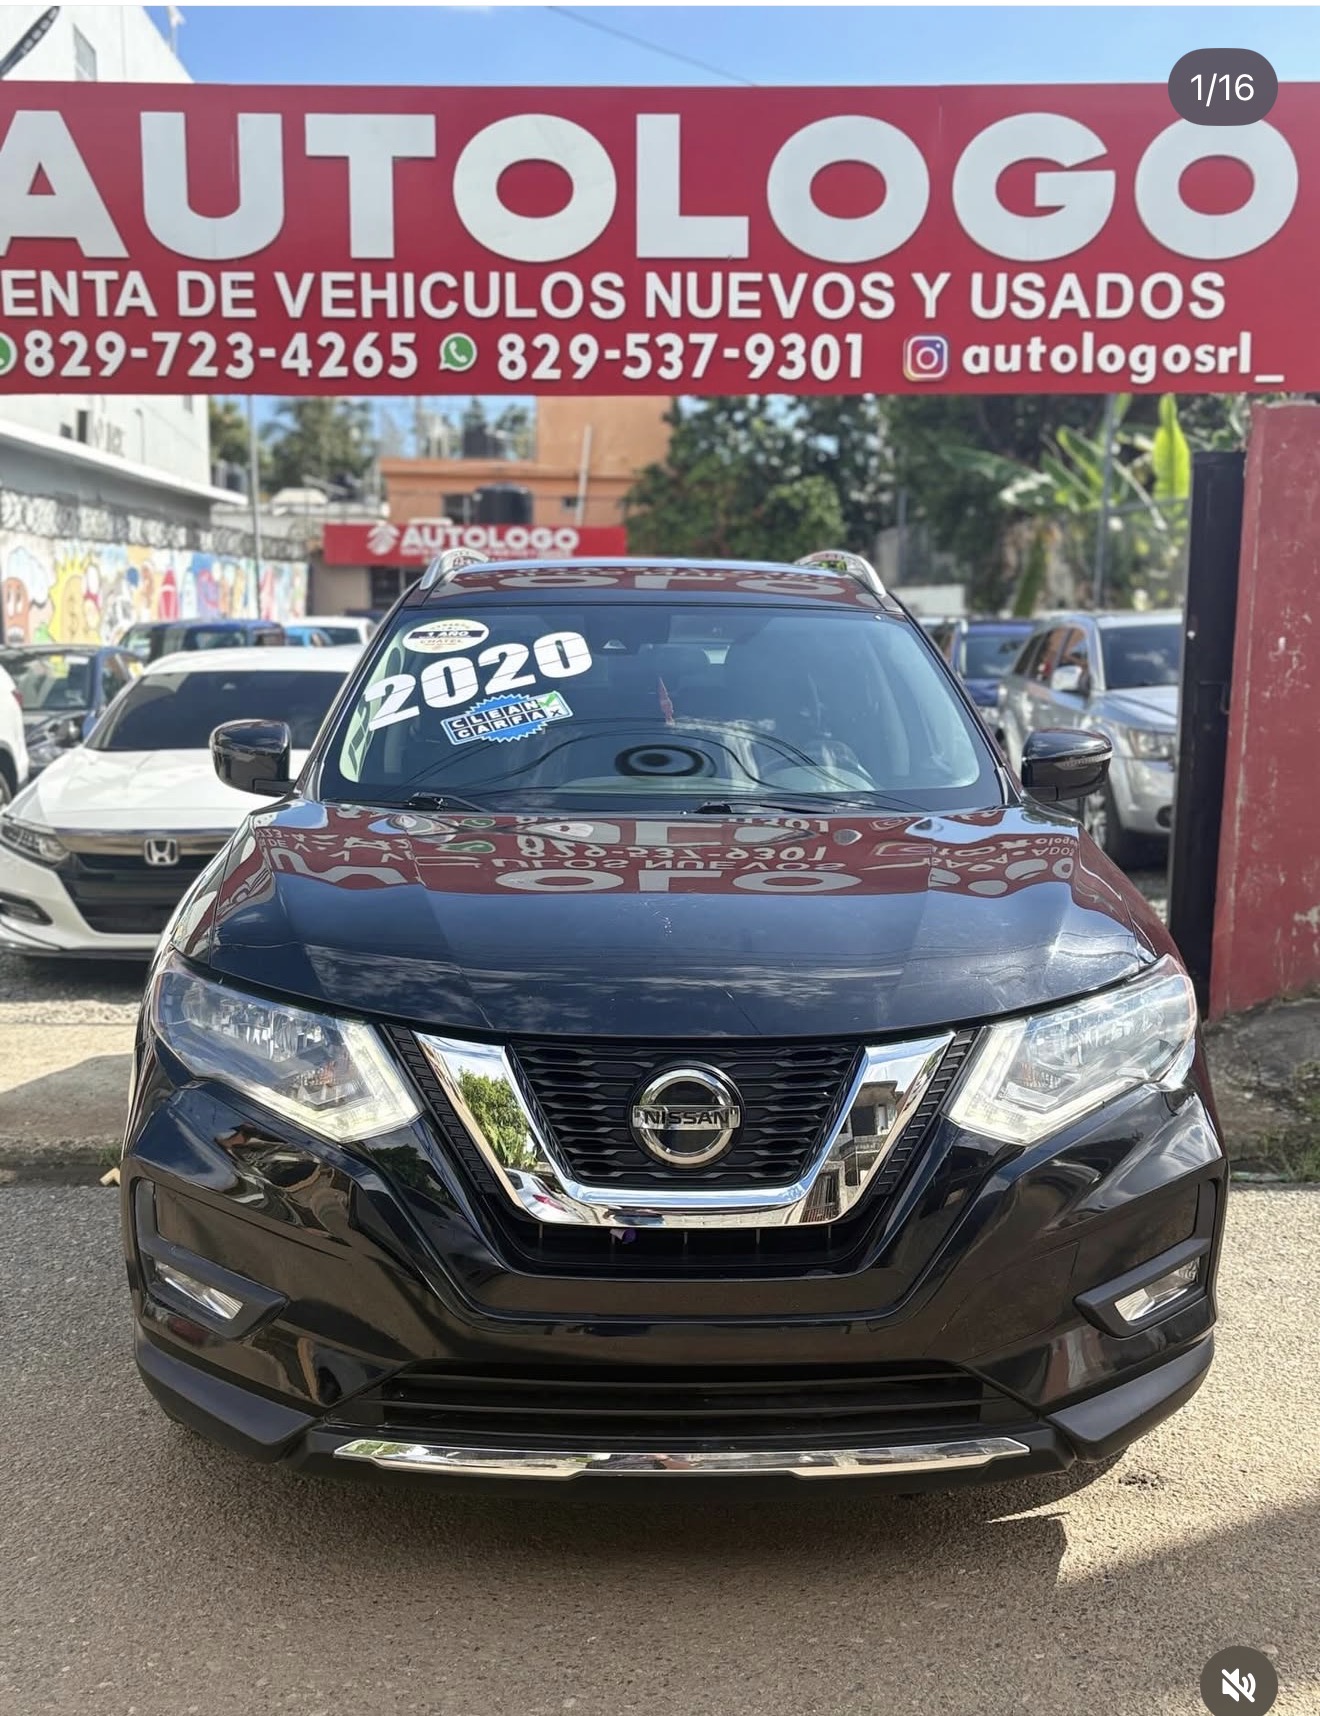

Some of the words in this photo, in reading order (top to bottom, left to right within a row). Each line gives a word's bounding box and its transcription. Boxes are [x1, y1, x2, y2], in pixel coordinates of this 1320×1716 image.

[0, 110, 1299, 263] AUTOLOGO
[178, 271, 257, 318] DE
[274, 271, 626, 319] VEHICULOS
[646, 271, 895, 320] NUEVOS
[911, 272, 951, 319] Y
[970, 271, 1226, 320] USADOS
[24, 329, 419, 379] 829-723-4265
[498, 331, 863, 381] 829-537-9301
[962, 331, 1284, 383] autologosrl_
[401, 526, 580, 550] AUTOLOGO
[365, 631, 593, 731] 2020
[452, 699, 540, 728] CLEAN
[458, 708, 562, 738] CARFAX
[644, 1110, 729, 1125] NISSAN
